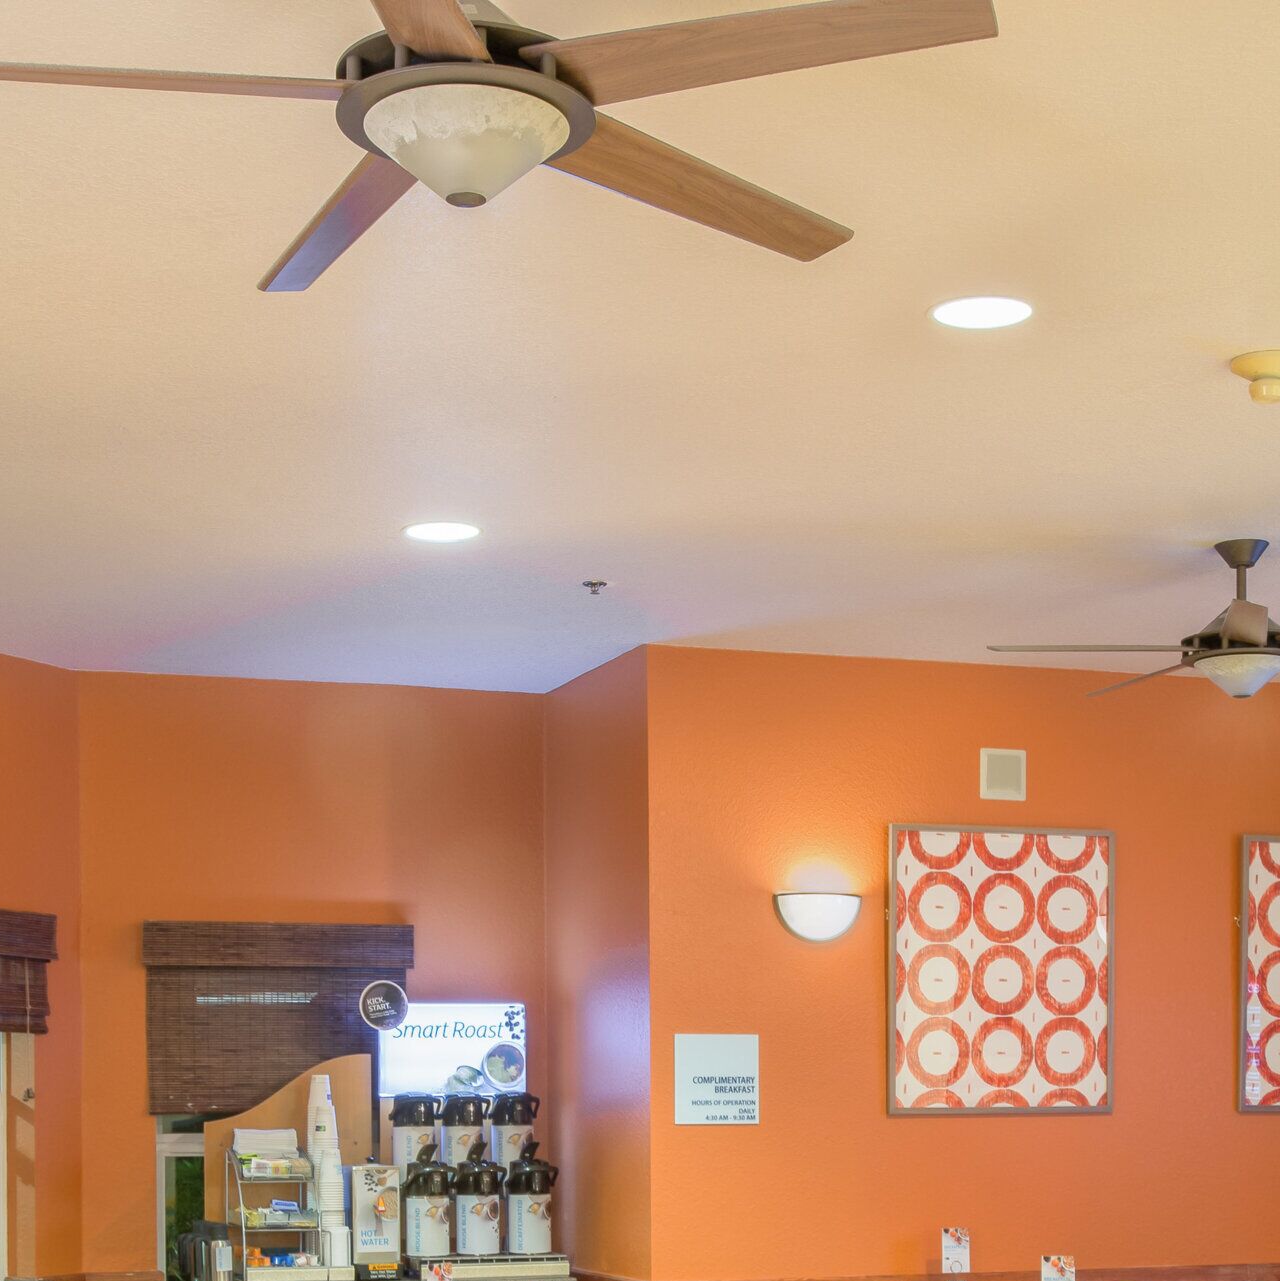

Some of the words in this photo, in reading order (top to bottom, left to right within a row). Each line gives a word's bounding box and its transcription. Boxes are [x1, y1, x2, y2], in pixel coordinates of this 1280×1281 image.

[392, 1021, 449, 1039] Smart
[452, 1021, 504, 1039] Roast
[692, 1076, 755, 1084] COMPLIMENTARY
[360, 1229, 377, 1237] HOT
[360, 1238, 390, 1246] WATER
